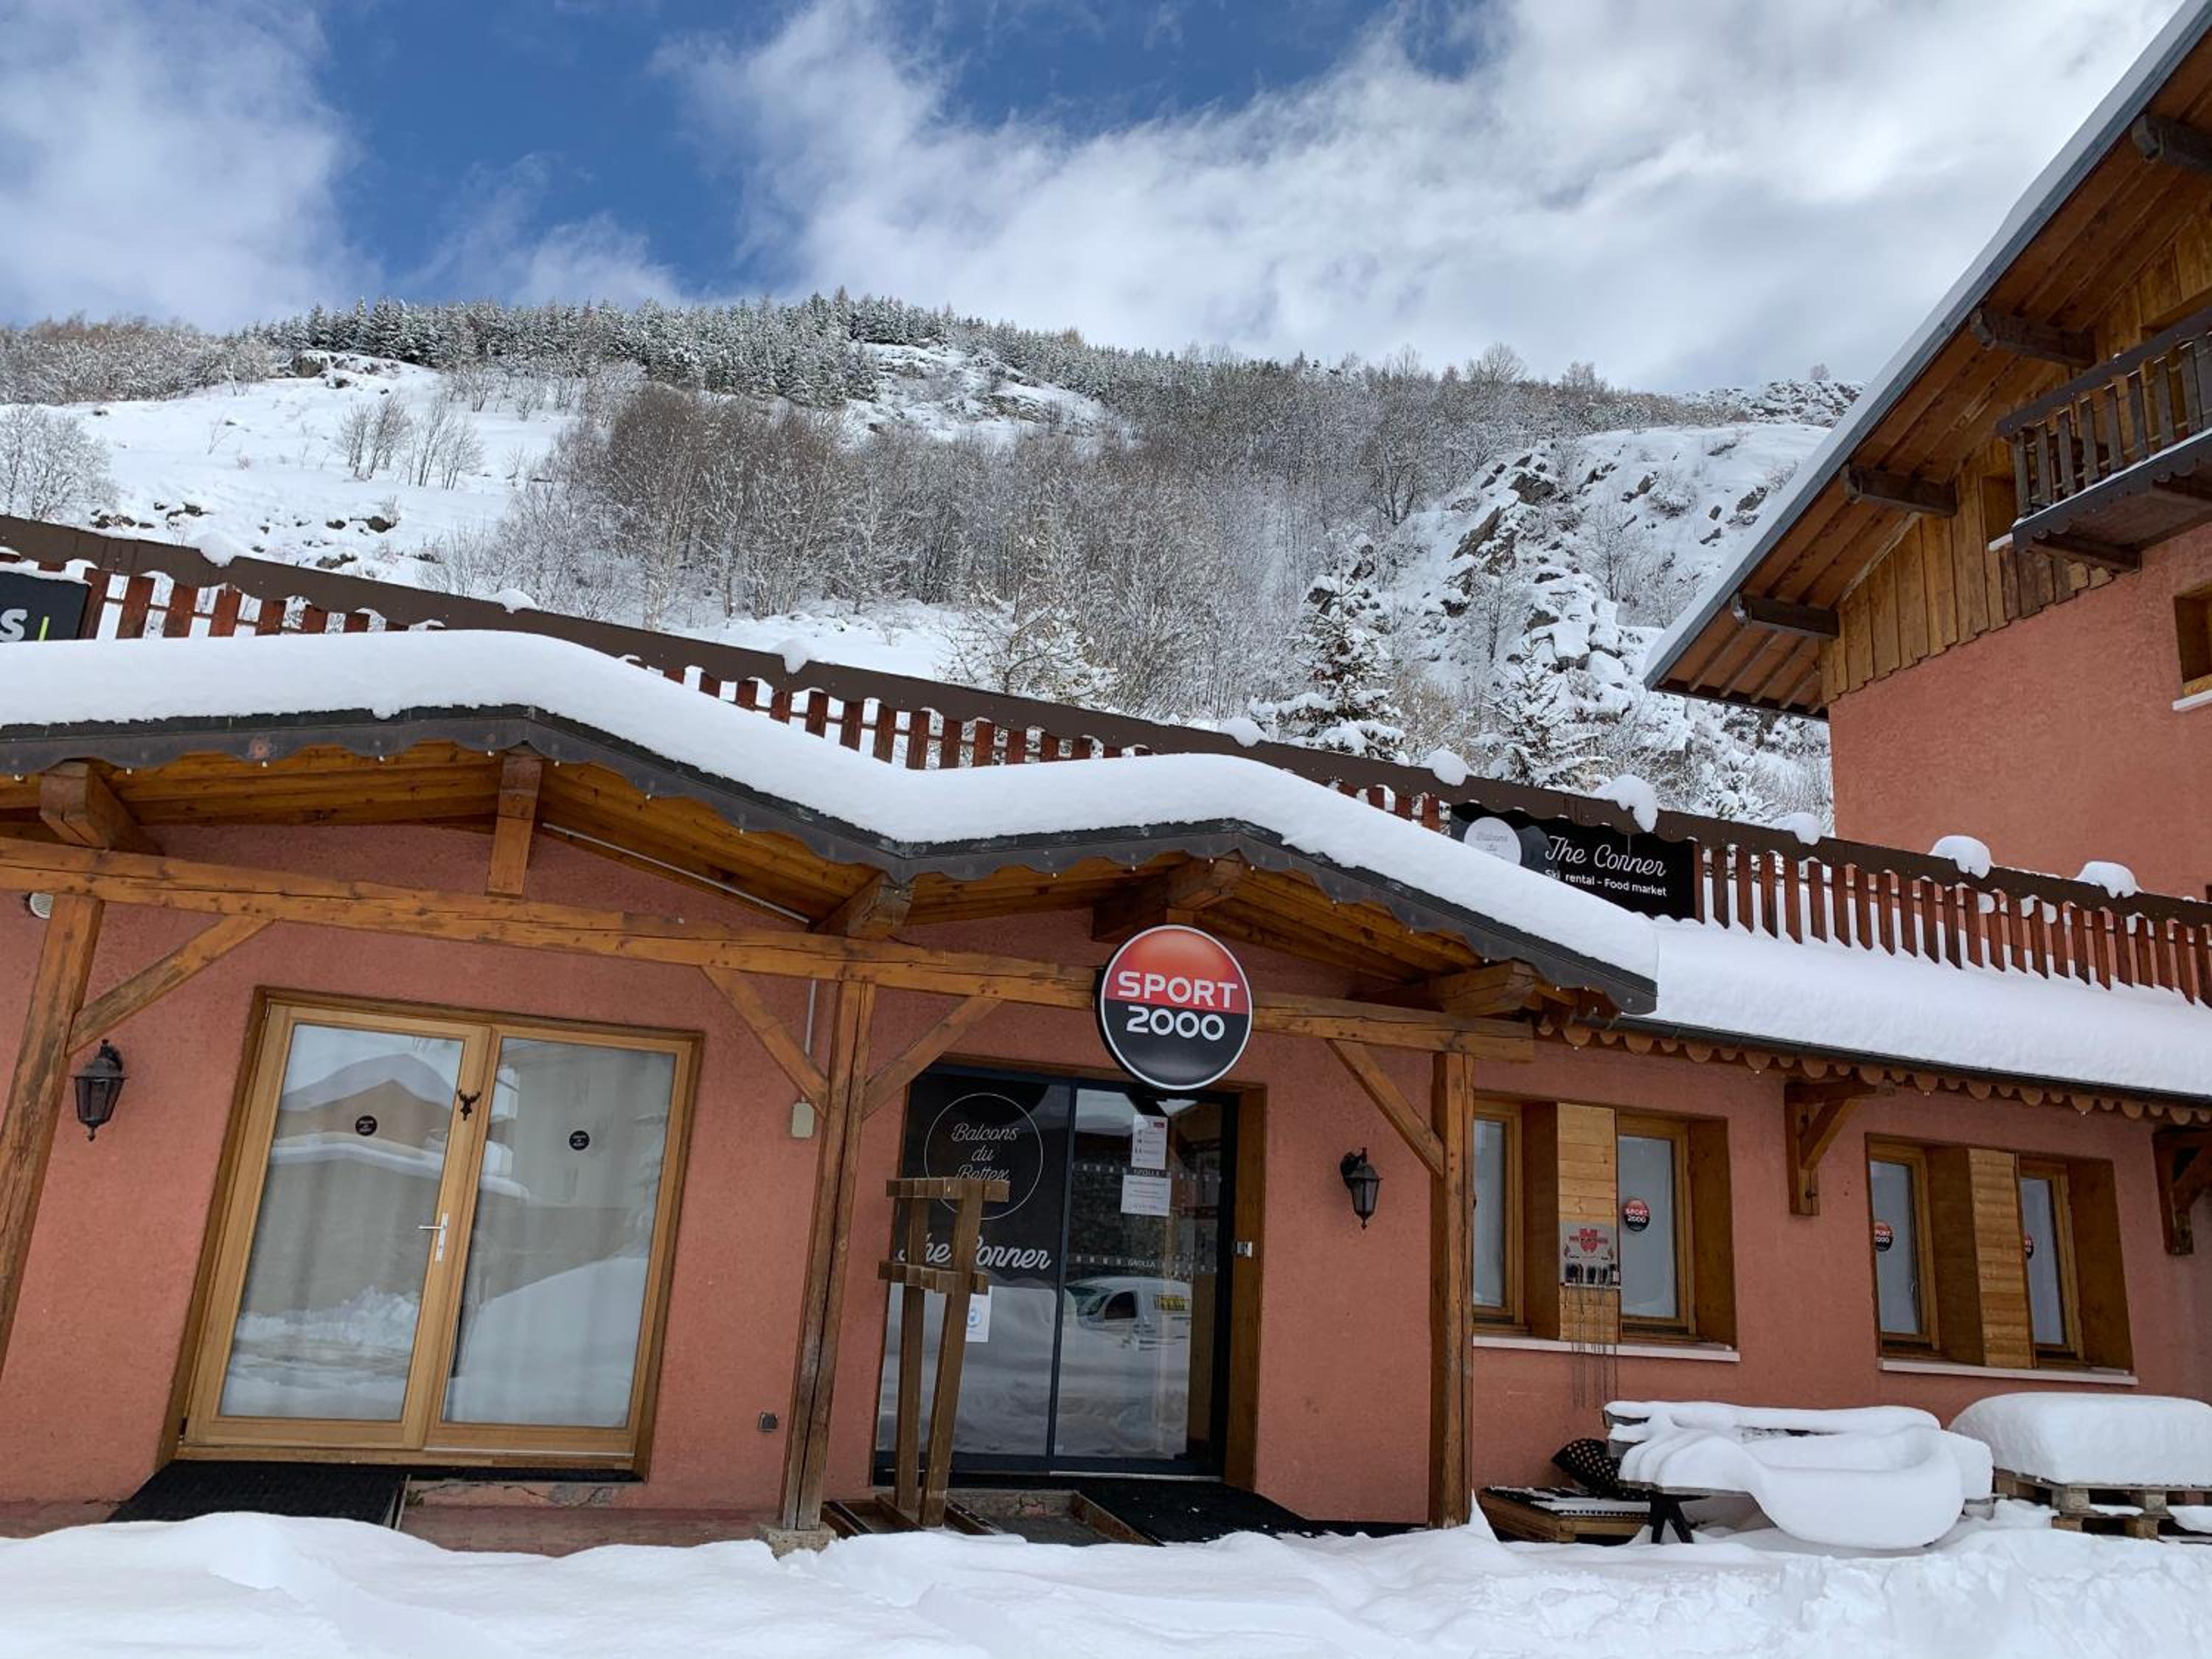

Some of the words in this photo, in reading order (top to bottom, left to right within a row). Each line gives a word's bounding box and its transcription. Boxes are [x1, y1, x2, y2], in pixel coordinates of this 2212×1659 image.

[1545, 835, 1587, 863] The
[1594, 844, 1666, 877] Corner
[1565, 874, 1595, 886] rental
[1604, 878, 1630, 891] Food
[1632, 884, 1668, 897] market
[1117, 970, 1238, 1009] SPORT
[1126, 1005, 1225, 1041] 2000
[951, 1123, 1020, 1141] Balcons
[971, 1144, 994, 1161] du
[1625, 1208, 1648, 1217] SPORT
[1627, 1215, 1646, 1223] 2000
[898, 1233, 953, 1264] he
[975, 1236, 1051, 1270] orner
